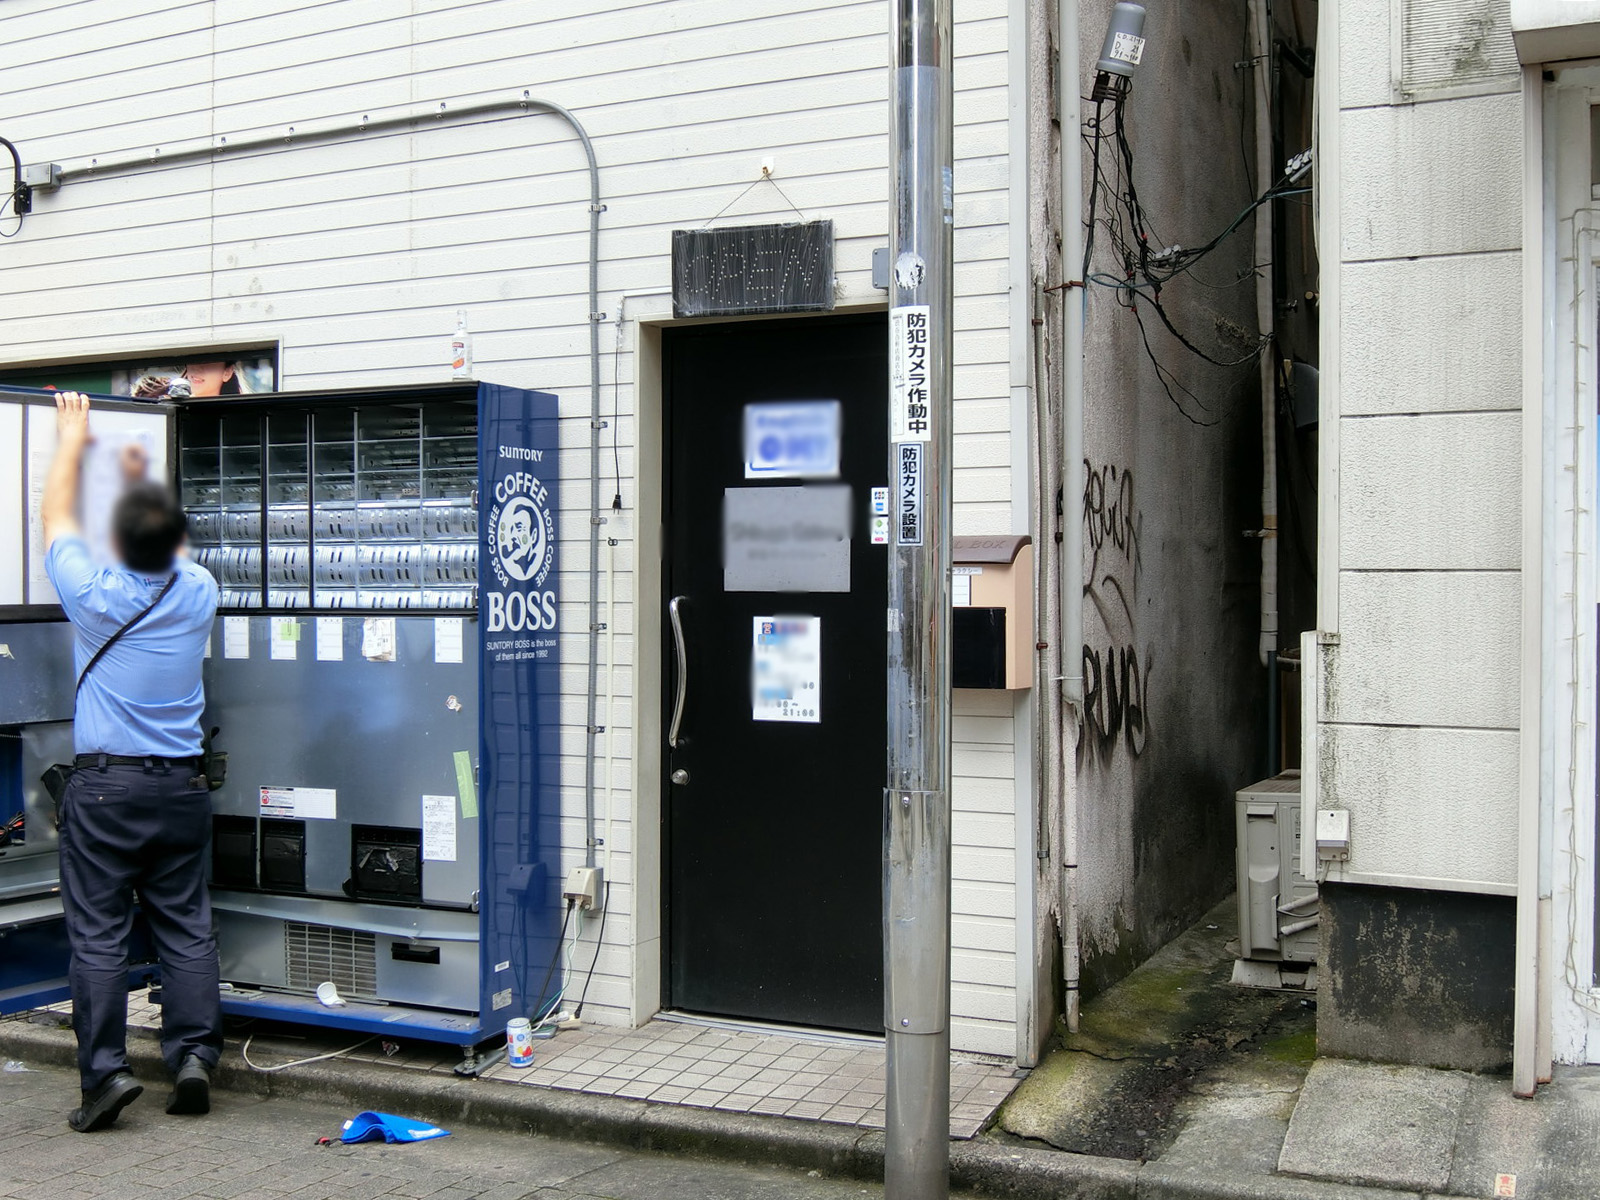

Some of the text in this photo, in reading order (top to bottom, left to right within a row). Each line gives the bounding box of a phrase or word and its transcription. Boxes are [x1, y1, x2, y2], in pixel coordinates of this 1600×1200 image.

[684, 248, 820, 293] OPEN
[907, 313, 927, 434] 防犯カメラ作動中
[499, 445, 543, 462] SUNTORY
[495, 472, 548, 507] COFFEE
[902, 447, 917, 539] 防犯カメラ設置
[488, 504, 509, 588] BOSS COFFEE
[535, 508, 554, 588] BOSS COFFEE
[487, 590, 556, 632] BOSS
[486, 638, 557, 651] SUNTORY BOSS is the boss
[495, 652, 501, 662] of
[502, 652, 515, 661] them
[522, 650, 535, 660] since
